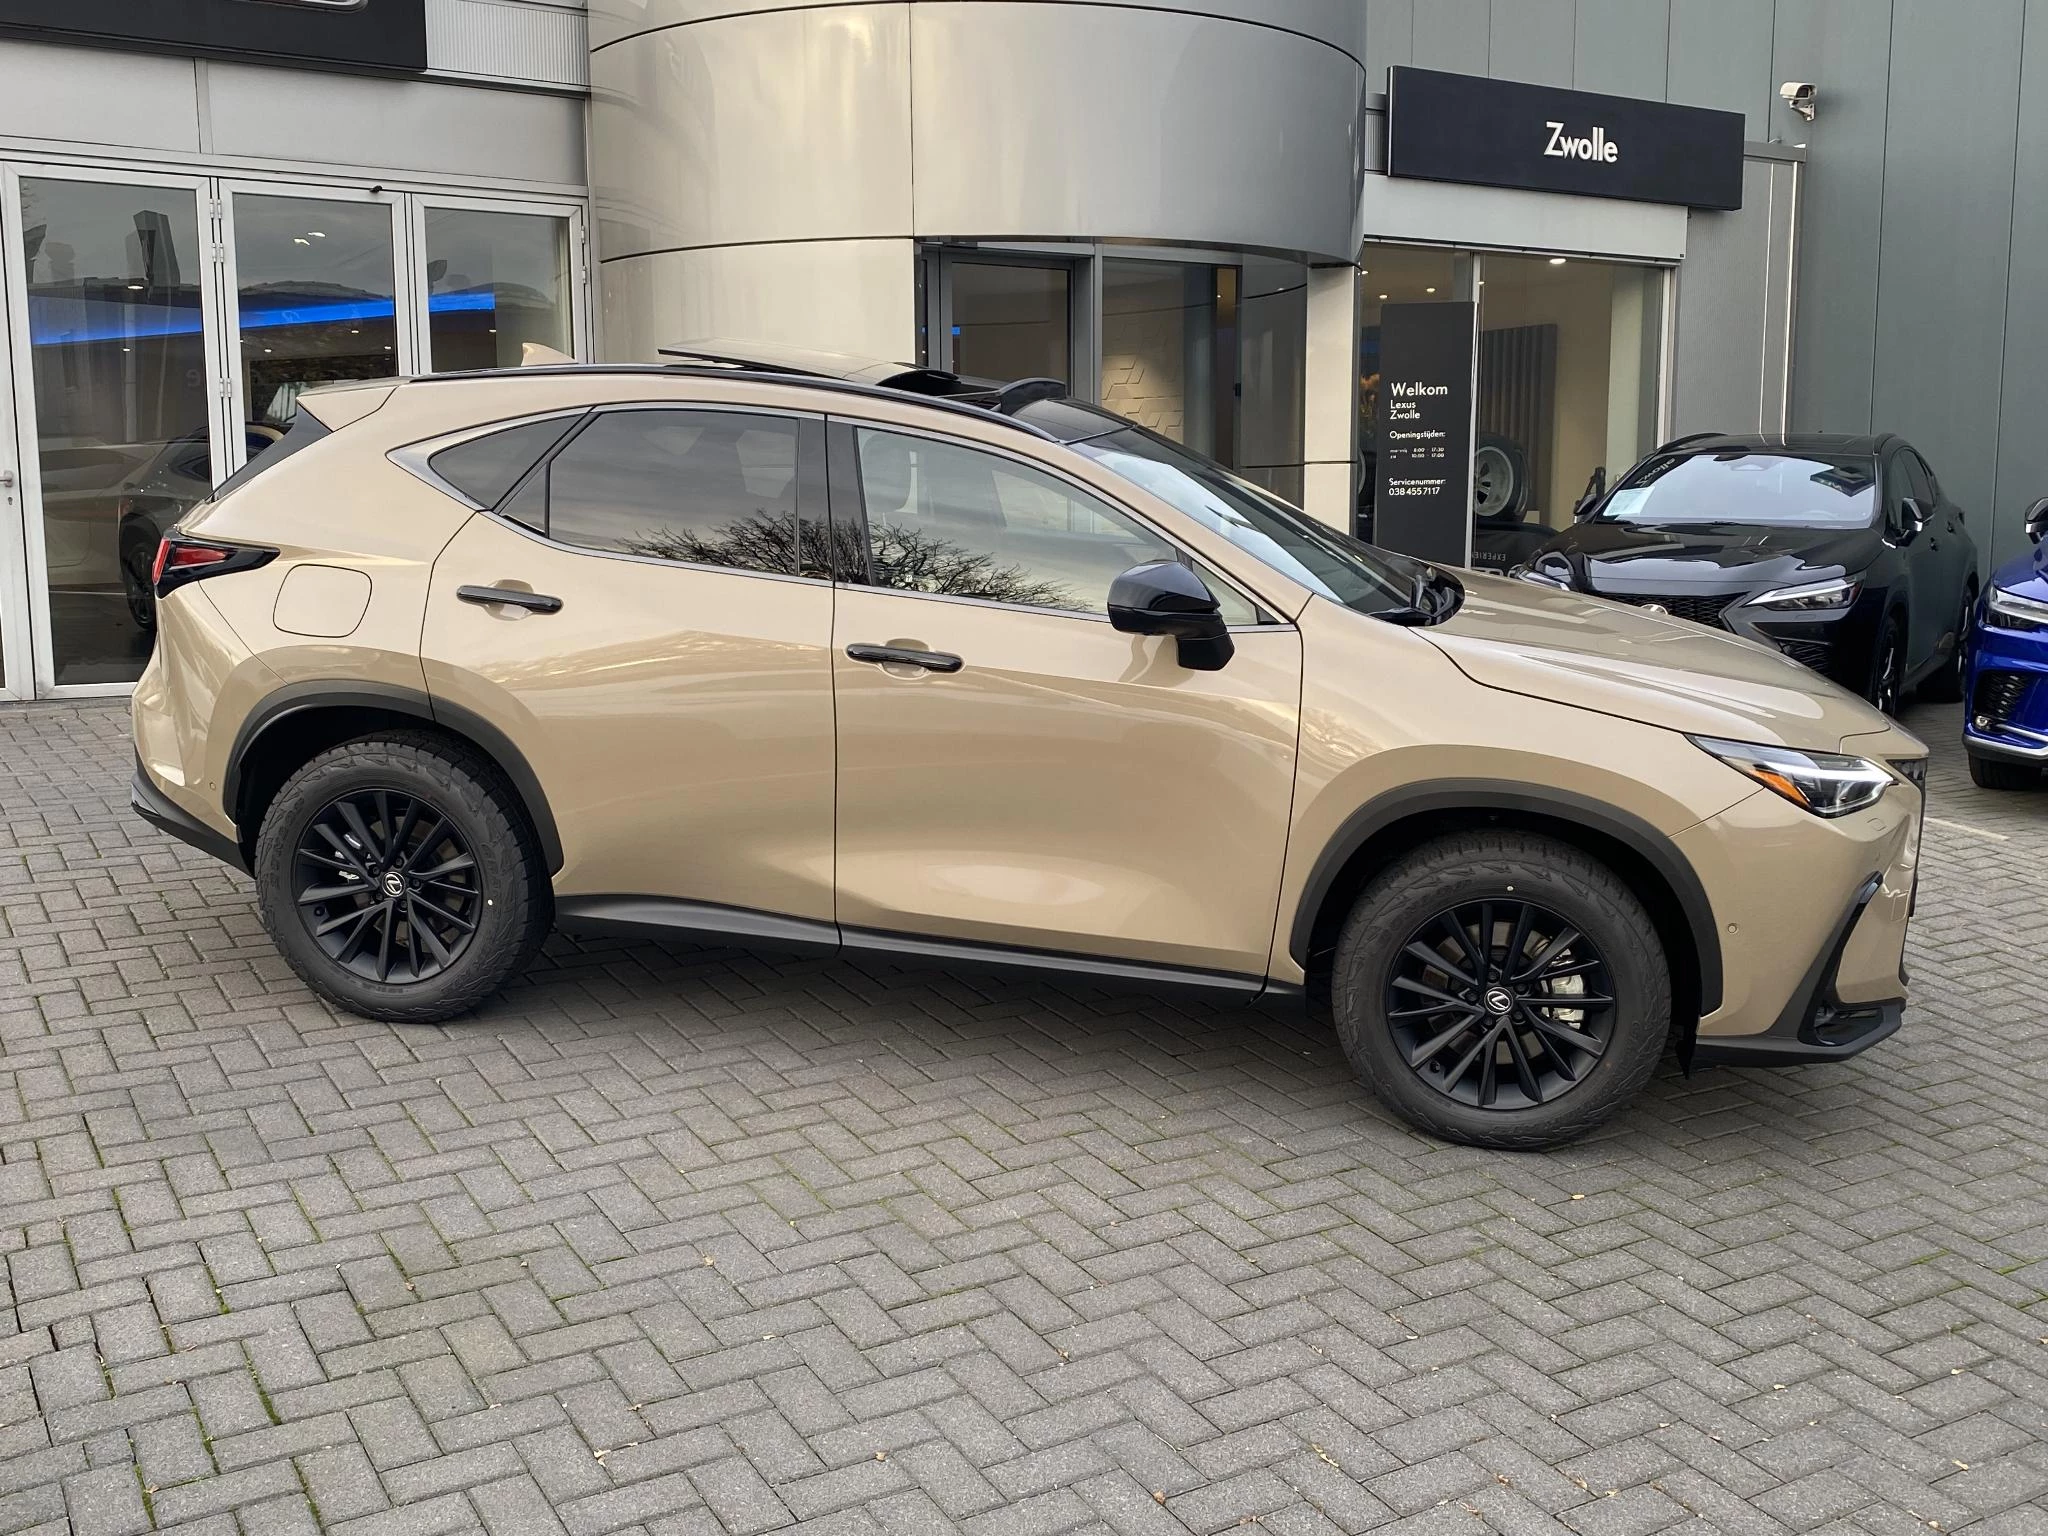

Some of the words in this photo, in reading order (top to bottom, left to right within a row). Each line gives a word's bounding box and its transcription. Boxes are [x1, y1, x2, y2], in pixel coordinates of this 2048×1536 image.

[1544, 121, 1618, 163] Zwolle
[1391, 381, 1448, 396] Welkom
[1390, 399, 1416, 409] Lexus
[1390, 409, 1420, 420] Zwolle
[1471, 551, 1506, 561] EXPERIE
